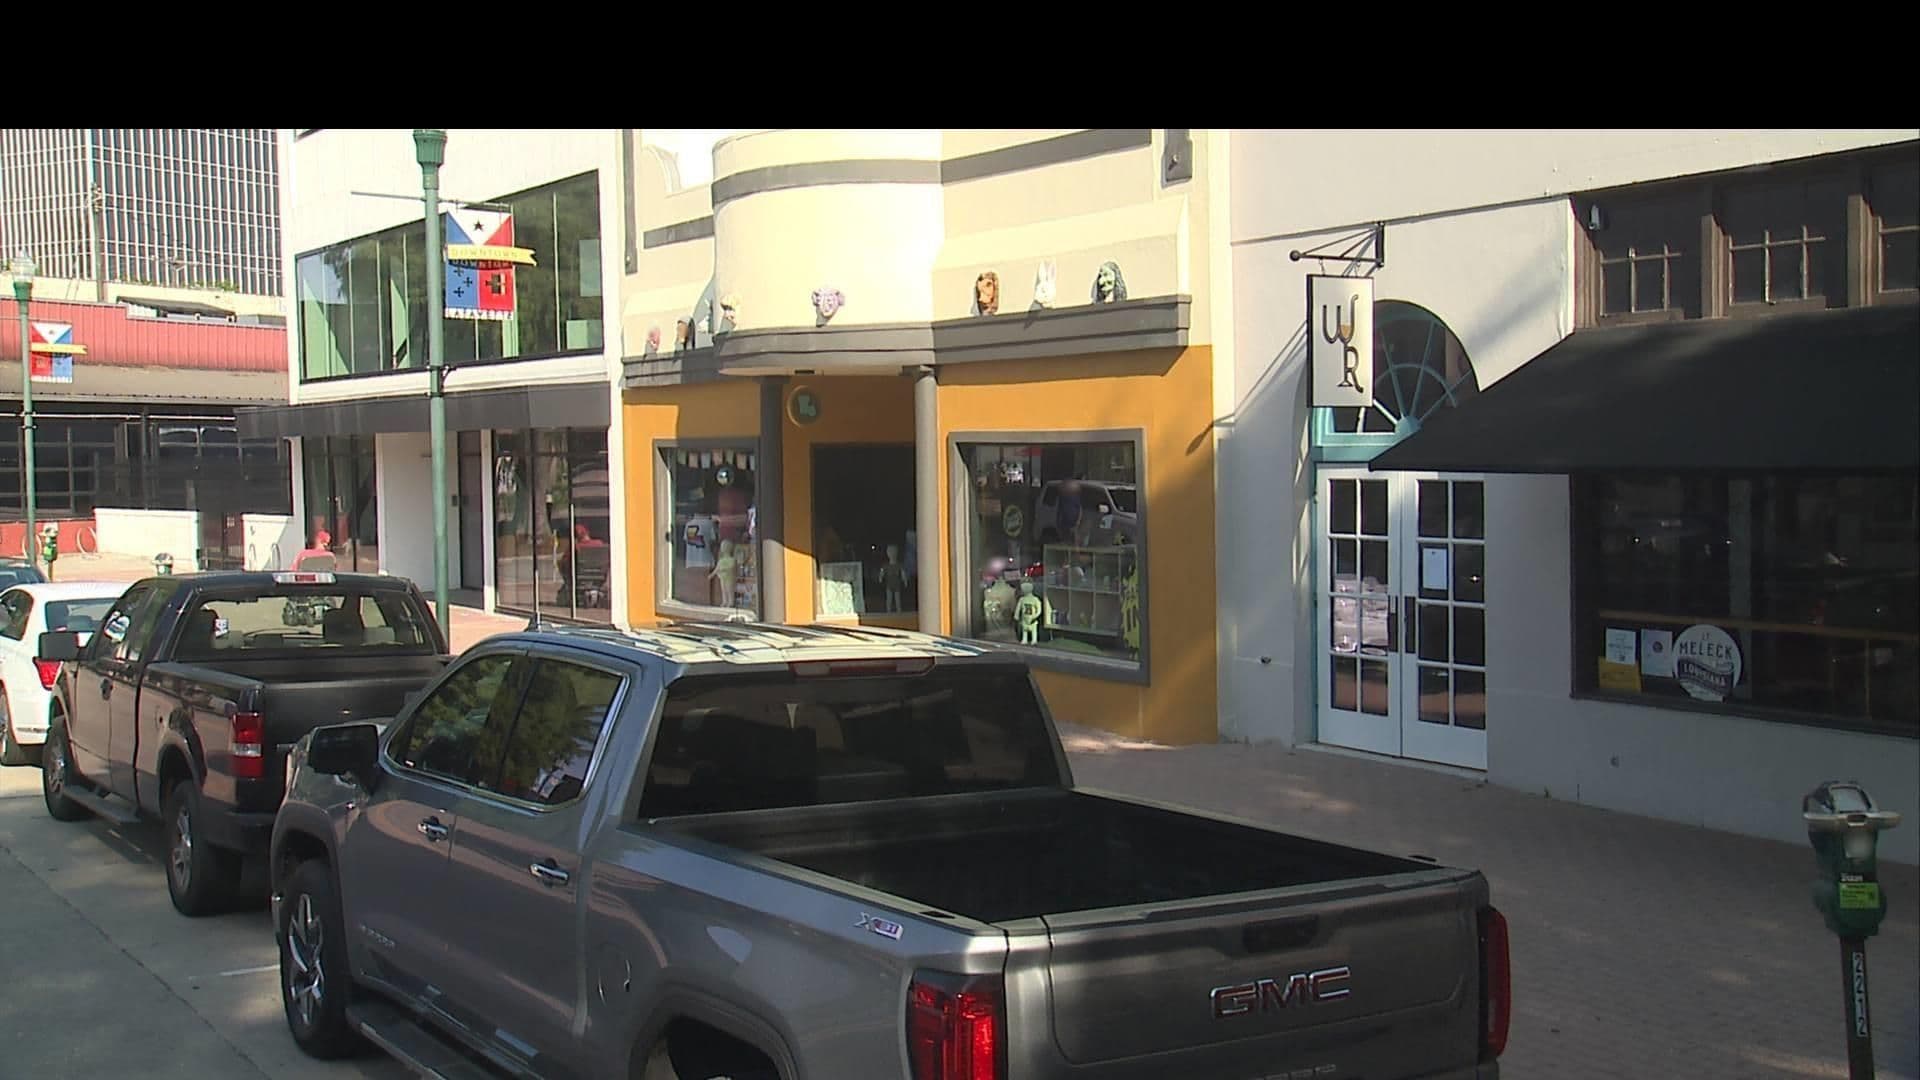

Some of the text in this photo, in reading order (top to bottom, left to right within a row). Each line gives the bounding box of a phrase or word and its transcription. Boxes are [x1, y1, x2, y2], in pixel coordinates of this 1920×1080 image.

[451, 246, 518, 258] DOWNTOWN
[1679, 641, 1733, 660] MELECK
[1210, 966, 1350, 1021] GMC
[1855, 952, 1867, 1036] 2212
